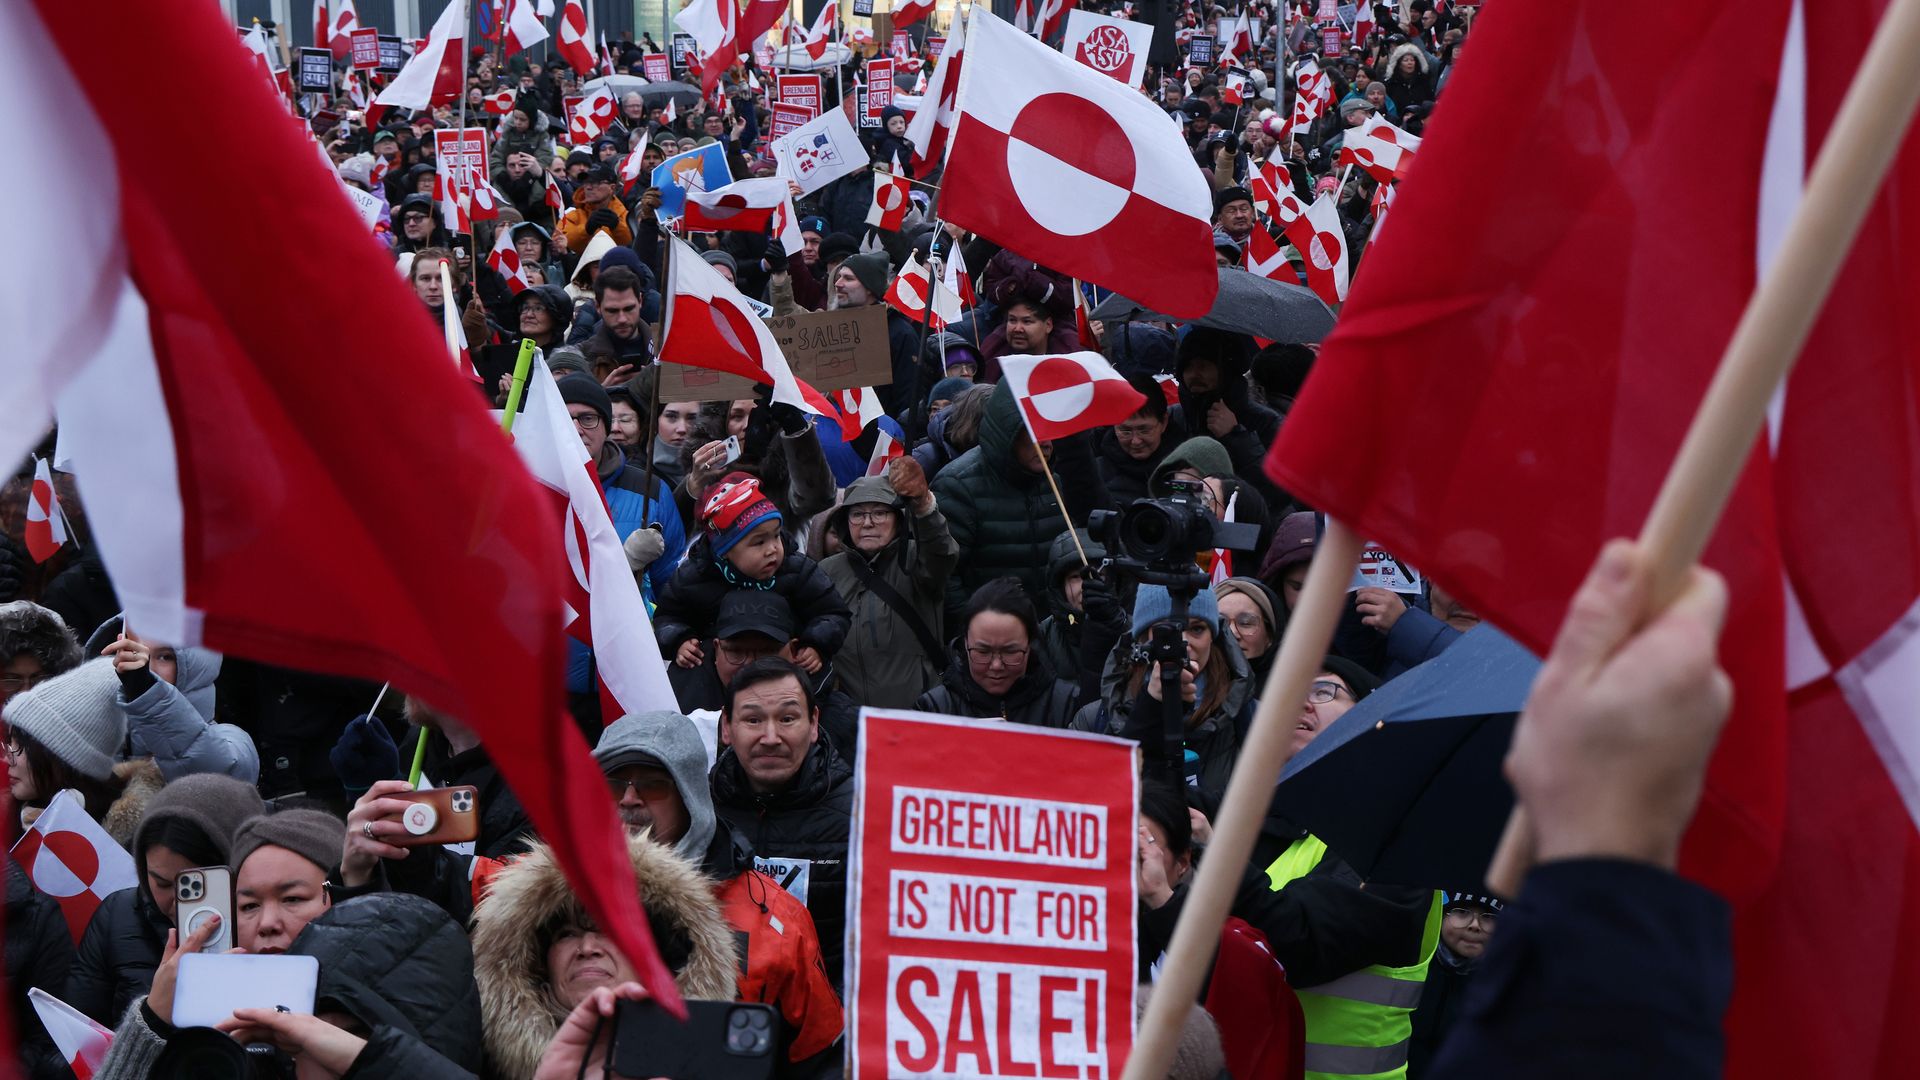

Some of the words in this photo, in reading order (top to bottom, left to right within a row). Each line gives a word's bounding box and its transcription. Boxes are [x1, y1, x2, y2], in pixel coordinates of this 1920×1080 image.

[784, 86, 816, 94] GREENLAND
[799, 320, 861, 350] SALE!
[730, 603, 779, 619] NYC
[900, 795, 1100, 859] GREENLAND
[897, 879, 928, 929] IS
[949, 883, 1017, 935] NOT
[1037, 890, 1099, 942] FOR
[895, 965, 1101, 1080] SALE!
